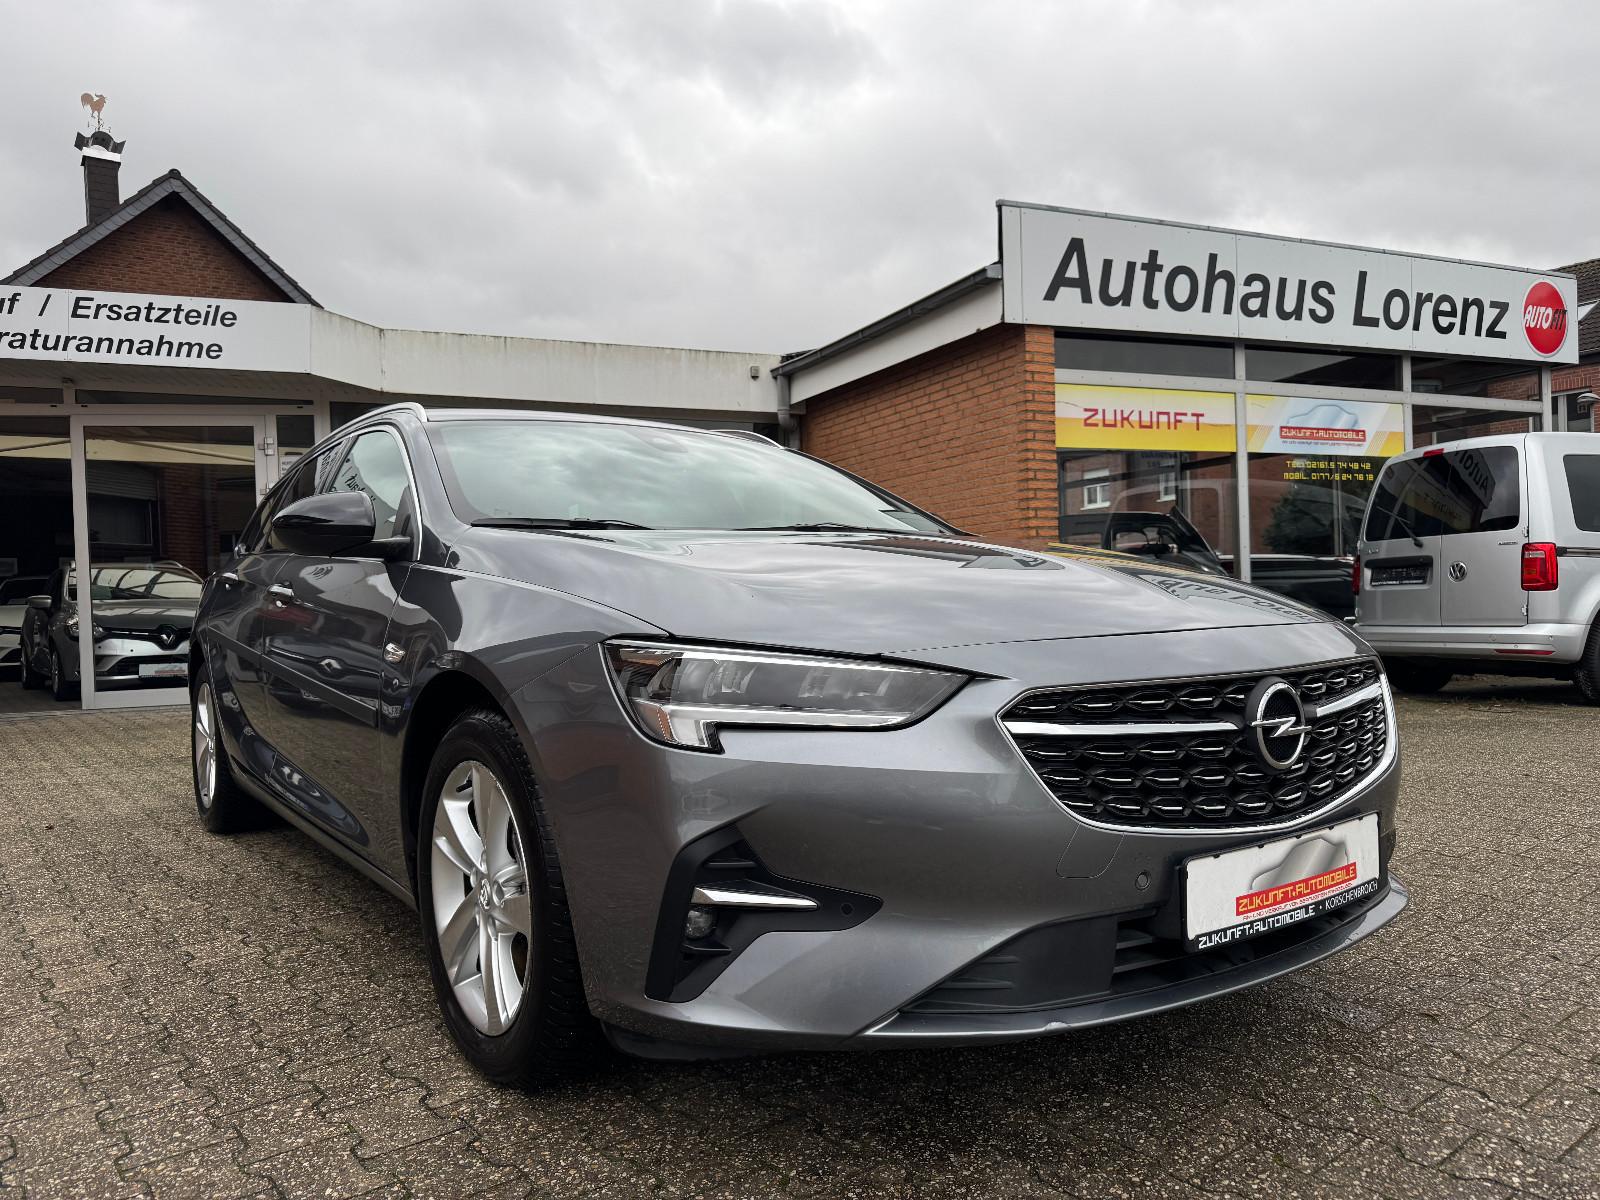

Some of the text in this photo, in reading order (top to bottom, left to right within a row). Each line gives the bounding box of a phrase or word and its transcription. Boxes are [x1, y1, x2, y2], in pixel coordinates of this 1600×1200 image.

[1043, 237, 1509, 339] Autohaus Lorenz
[71, 297, 238, 328] Ersatzteile
[1083, 407, 1205, 431] ZUKUNFT
